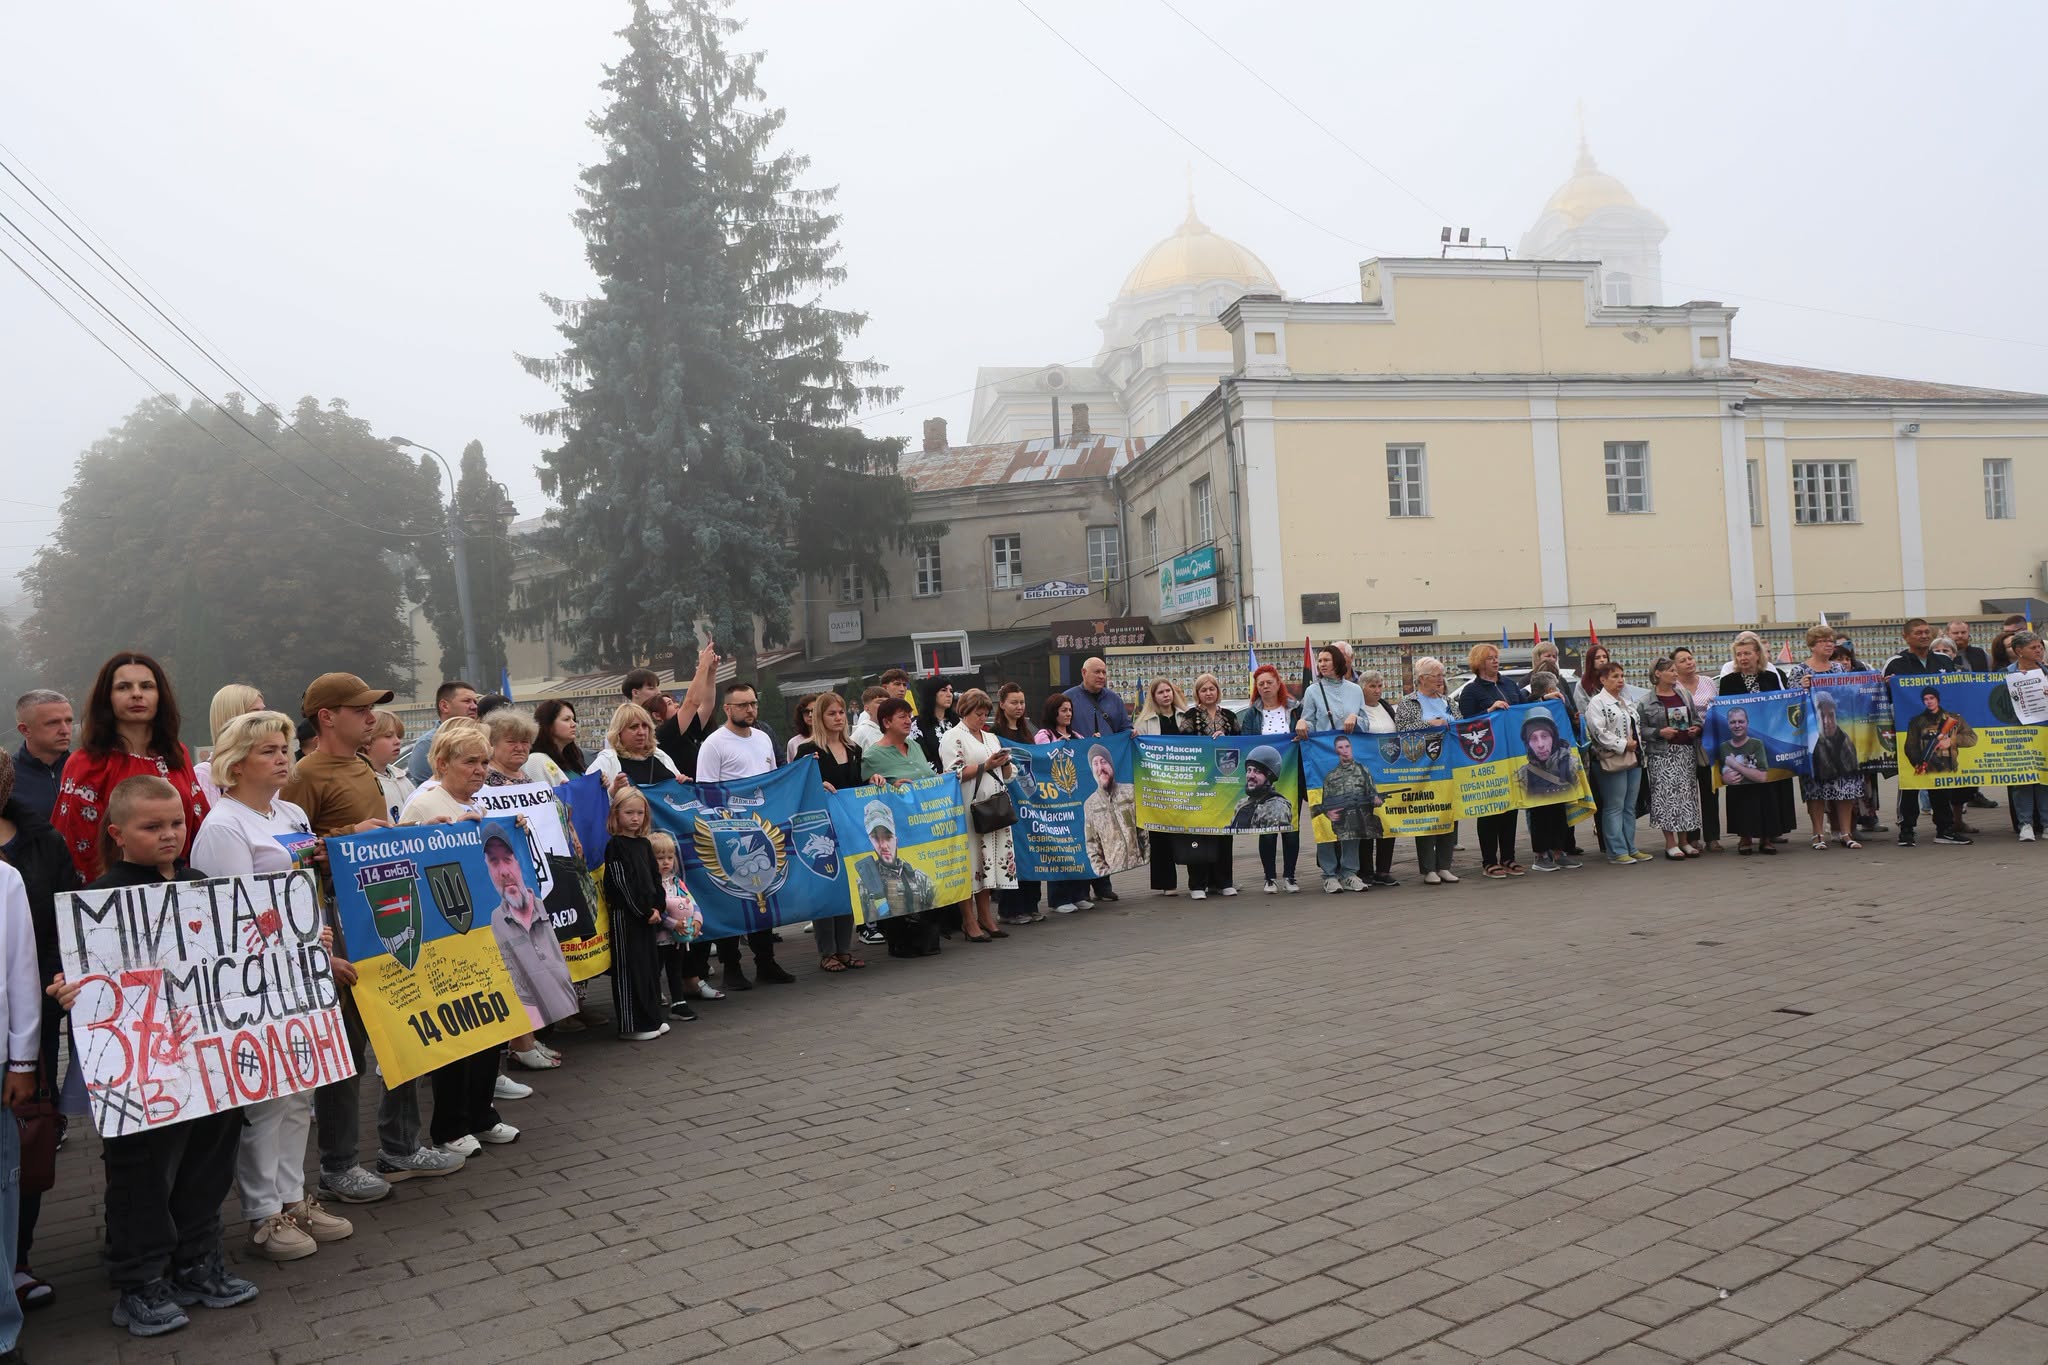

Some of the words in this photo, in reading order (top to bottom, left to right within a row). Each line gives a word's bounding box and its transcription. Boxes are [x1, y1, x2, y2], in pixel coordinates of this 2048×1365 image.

[1026, 588, 1086, 599] БІБЛІОТЕКА
[1178, 586, 1211, 605] КНИГАРНЯ
[1899, 675, 1940, 687] БЕЗВІСТИ
[1139, 743, 1163, 753] Ожго
[1166, 744, 1202, 753] Максим
[1145, 751, 1197, 762] Сергійович
[1141, 762, 1162, 770] ЗНИК
[1163, 764, 1205, 773] БЕЗВІСТИ
[1471, 769, 1477, 778] А
[1477, 765, 1496, 778] 4862
[1150, 770, 1193, 780] 01.04.2025
[1934, 774, 1984, 787] ВІРИМО!
[1037, 782, 1059, 799] 36
[1460, 780, 1485, 793] ГОРБАЧ
[1401, 791, 1434, 802] САГАЙНО
[1385, 805, 1407, 815] Антон
[340, 836, 425, 864] Чекаємо
[427, 826, 483, 852] вдома!
[364, 867, 380, 883] 14
[384, 865, 409, 879] омбр
[71, 884, 188, 975] МІЙ
[190, 870, 321, 958] ТАТО
[79, 968, 167, 1091] 37
[408, 1010, 443, 1047] 14
[139, 1079, 181, 1125] В
[193, 1009, 357, 1113] ПОЛОНІ
